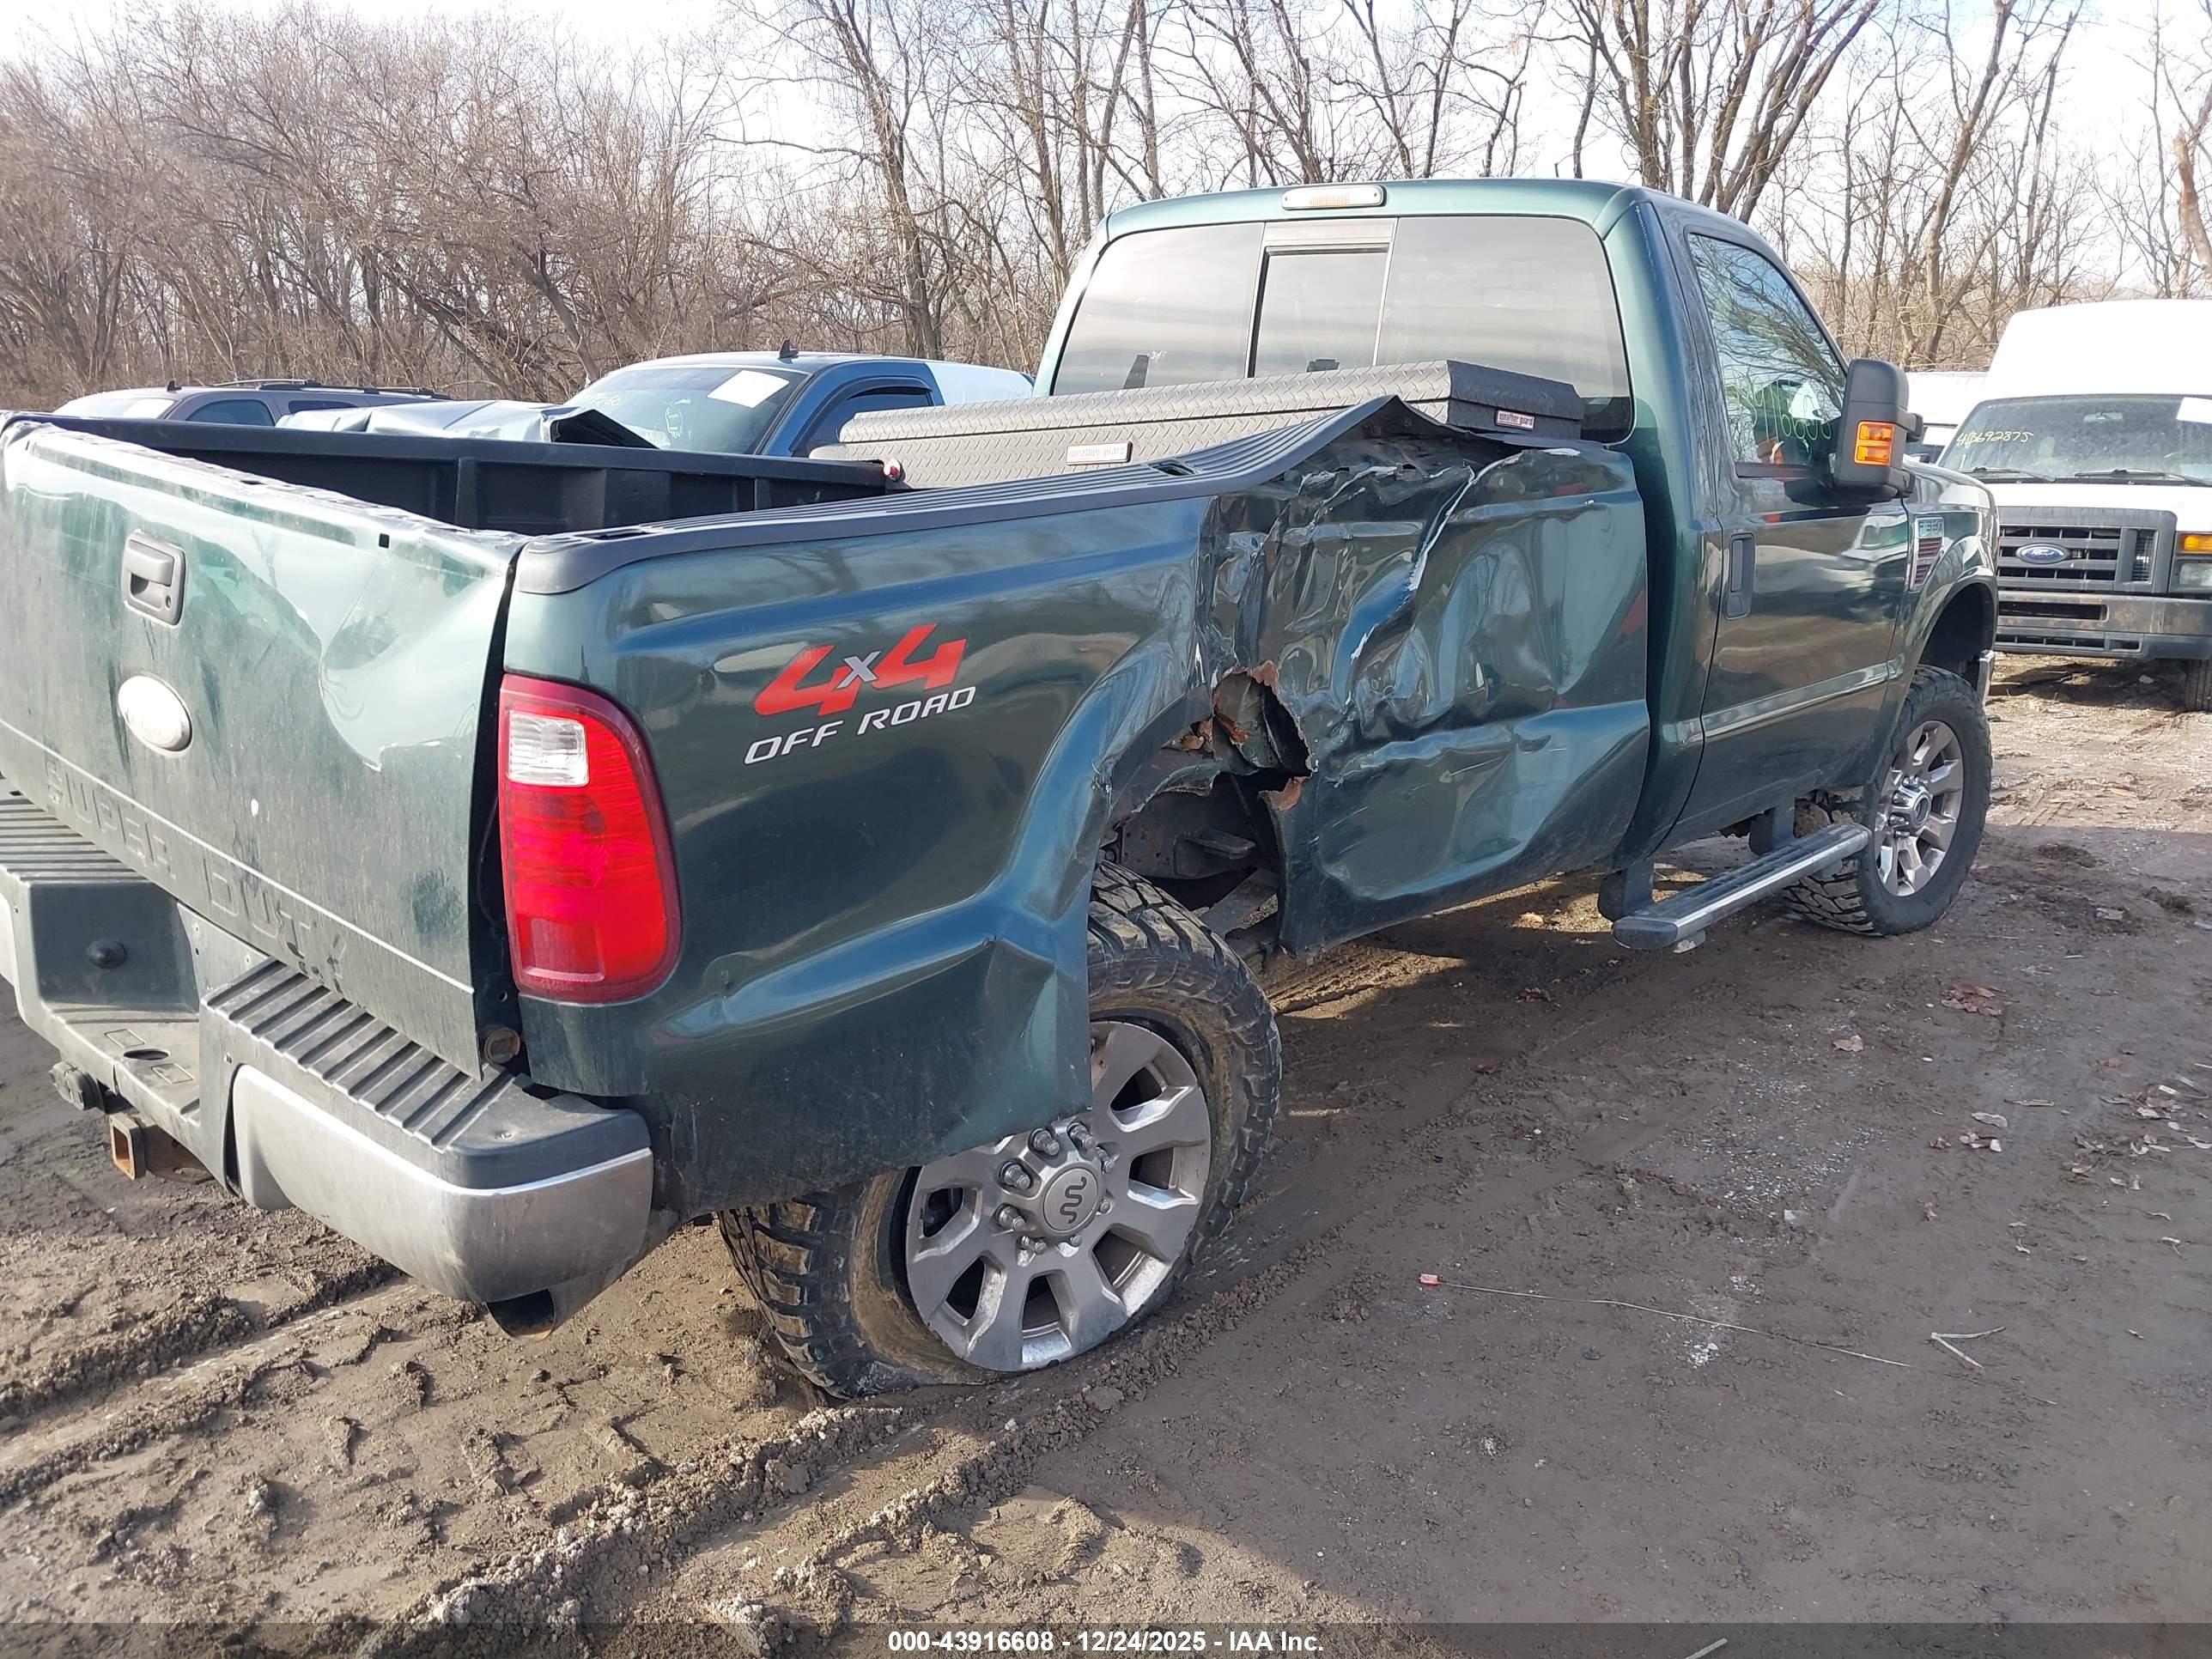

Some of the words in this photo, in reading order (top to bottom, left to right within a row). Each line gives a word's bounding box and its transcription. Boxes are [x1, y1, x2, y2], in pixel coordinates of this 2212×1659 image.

[744, 720, 844, 765] OFF
[857, 686, 976, 735] ROAD
[45, 757, 177, 881] SUPER
[203, 858, 347, 994] DUTY
